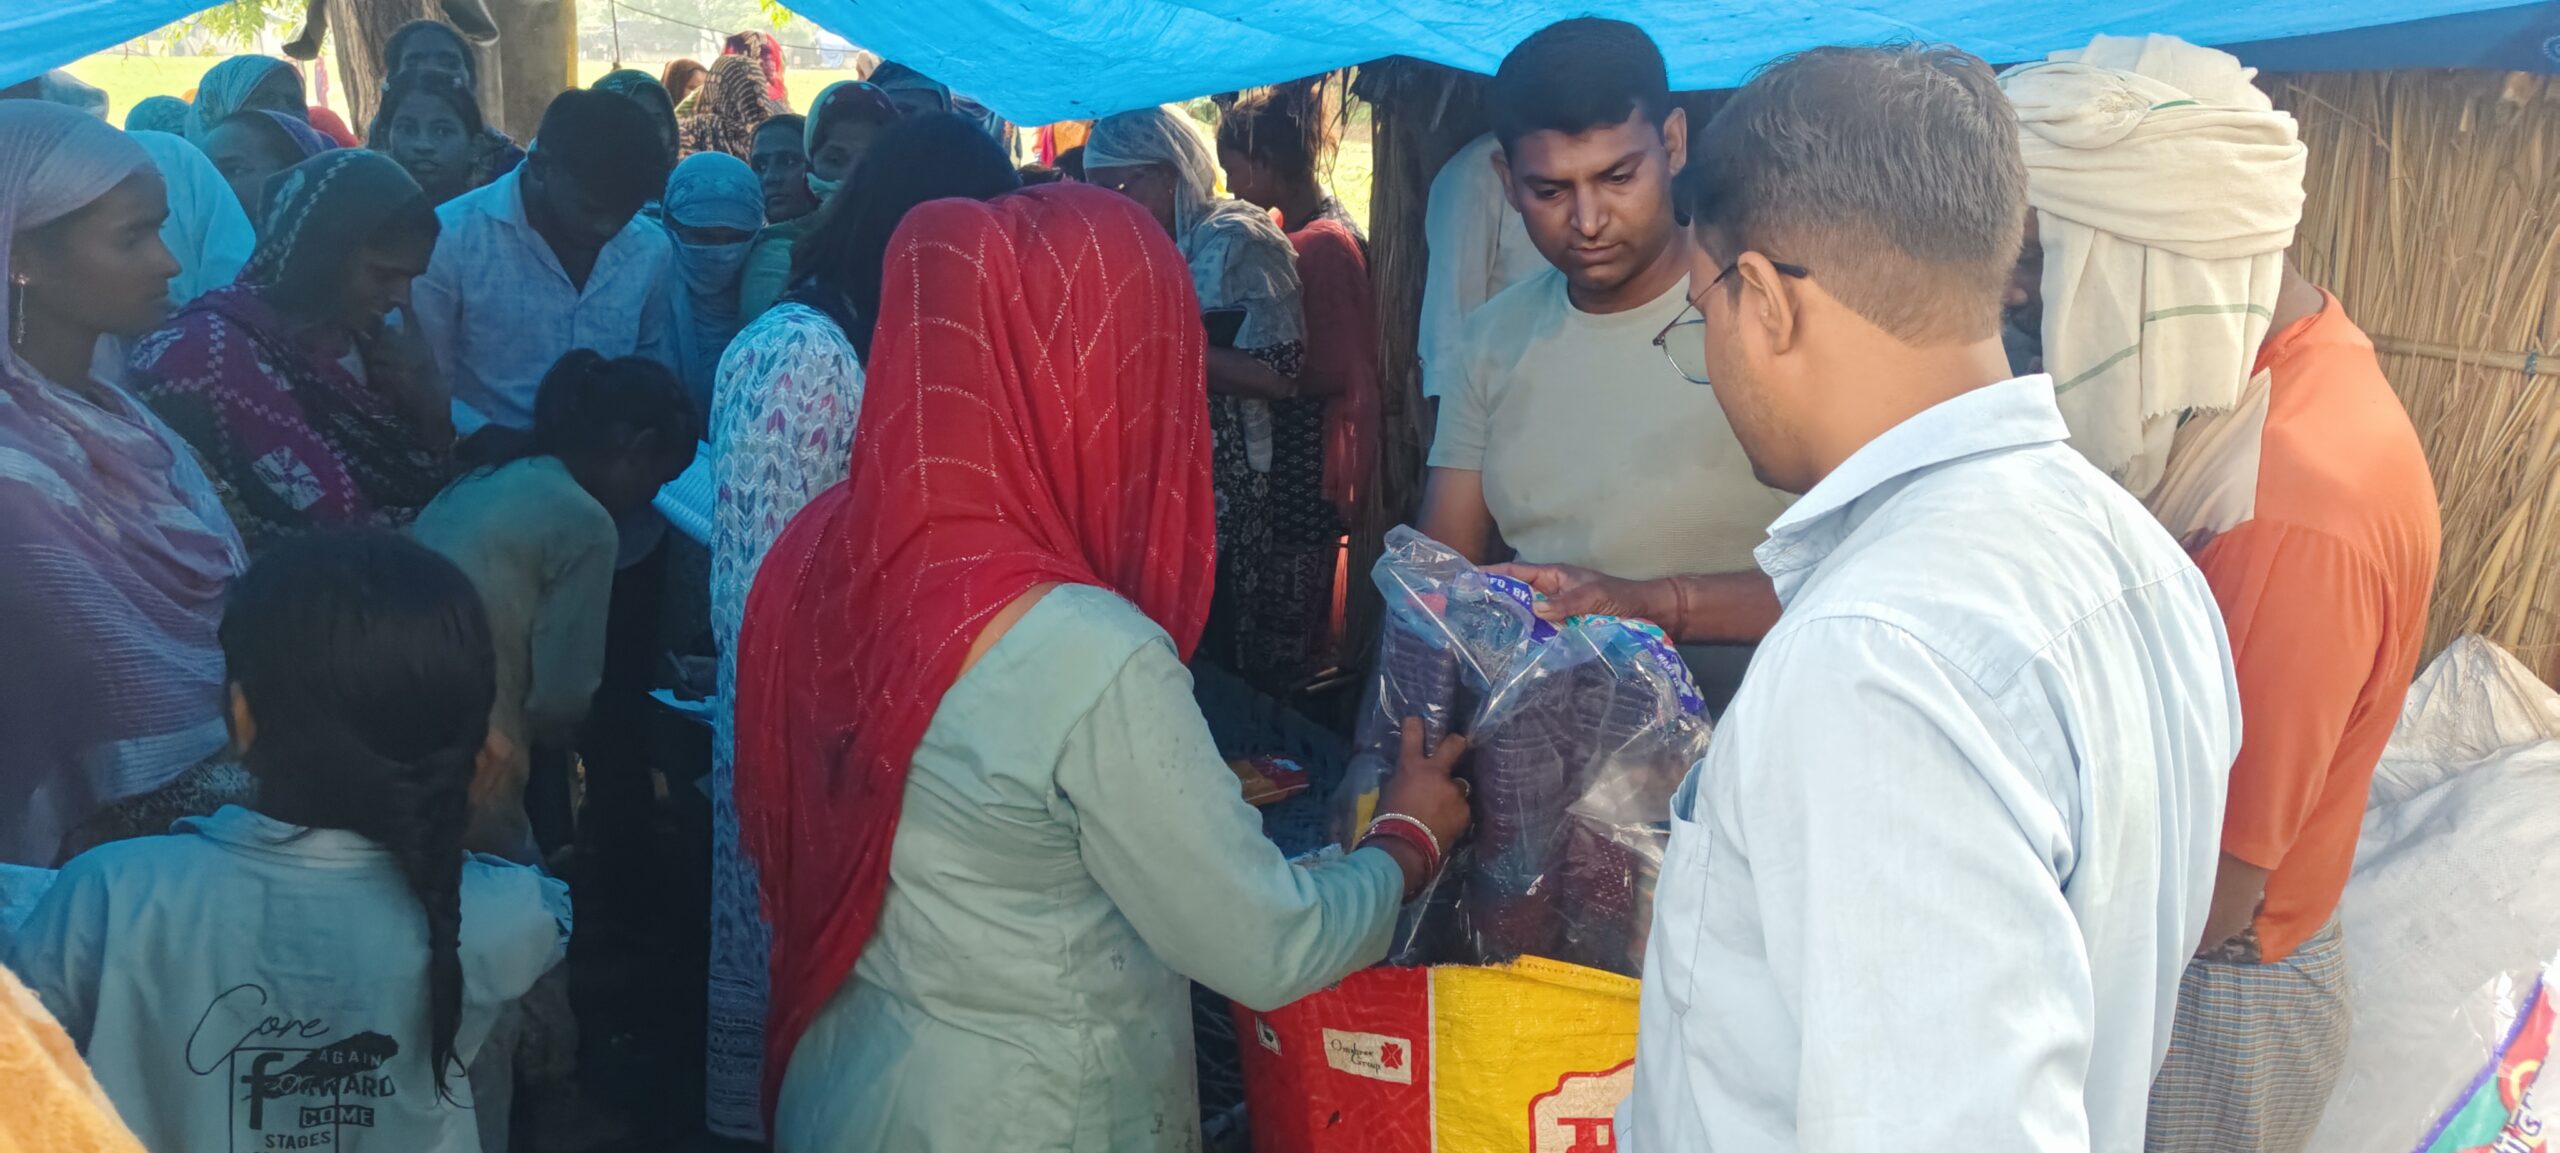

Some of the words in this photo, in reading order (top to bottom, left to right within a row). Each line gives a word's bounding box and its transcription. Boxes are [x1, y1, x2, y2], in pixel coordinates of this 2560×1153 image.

[319, 1050, 382, 1067] AGAIN
[301, 1106, 374, 1127] COME
[265, 1130, 332, 1150] STAGES
